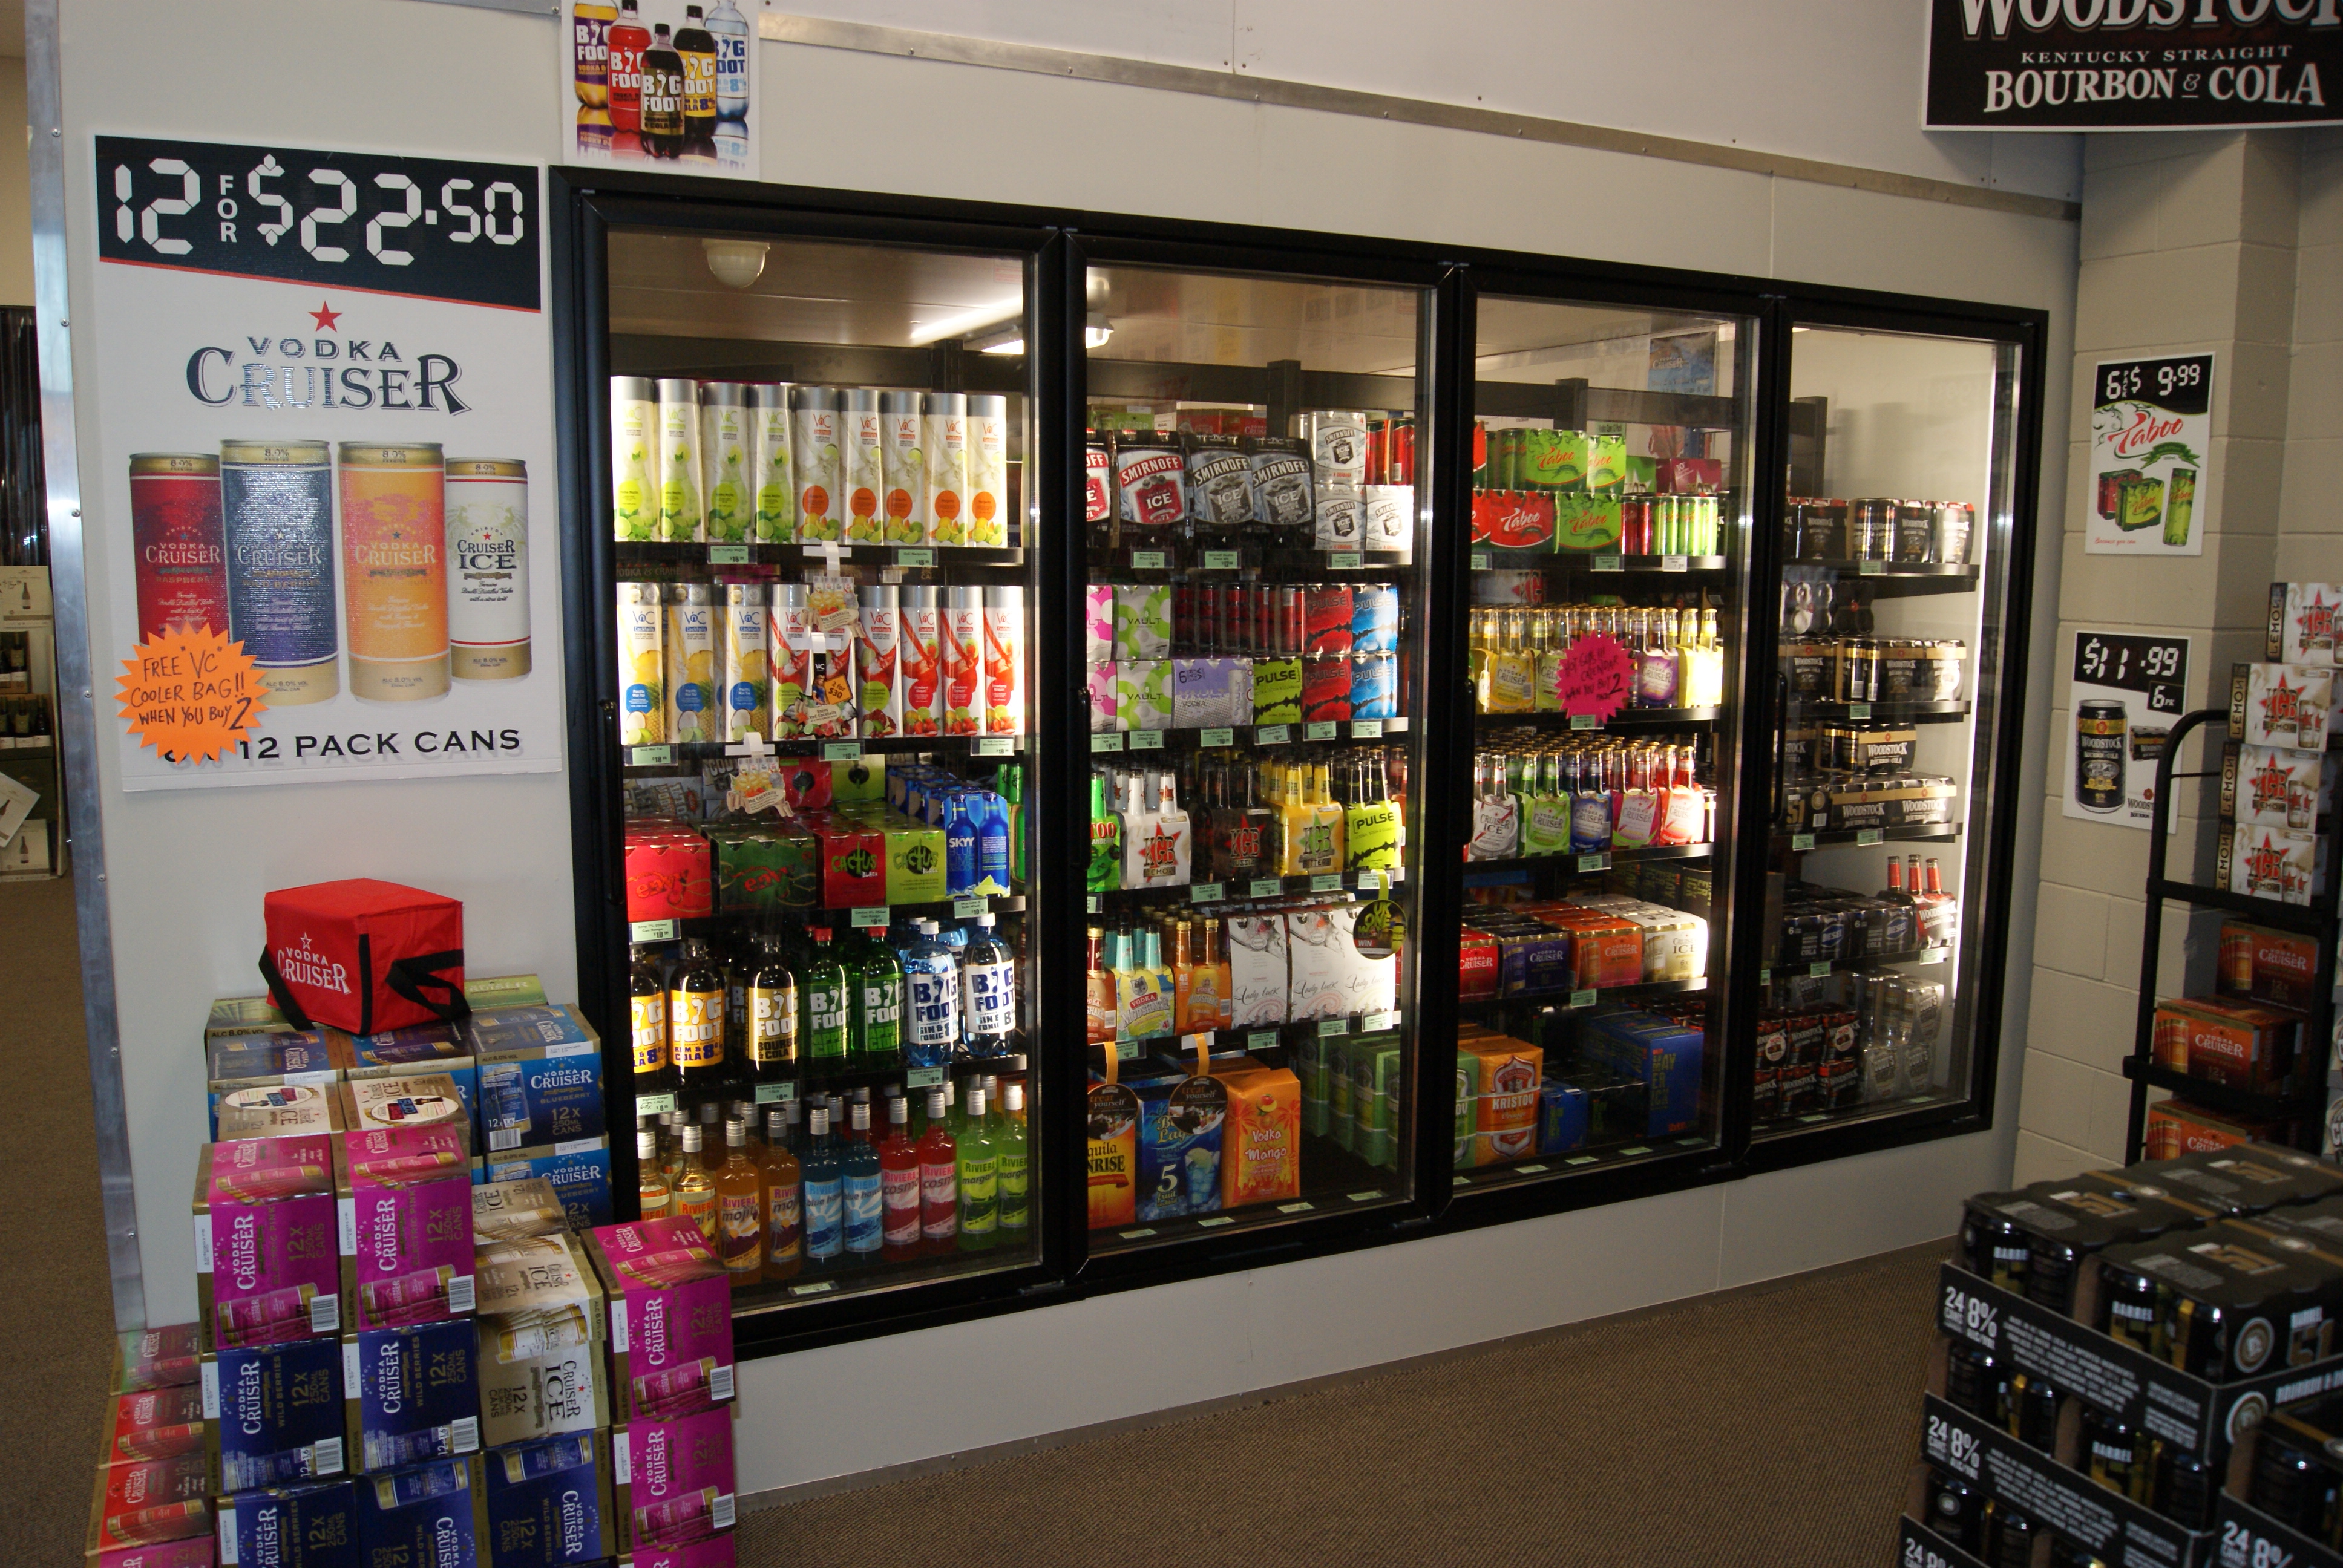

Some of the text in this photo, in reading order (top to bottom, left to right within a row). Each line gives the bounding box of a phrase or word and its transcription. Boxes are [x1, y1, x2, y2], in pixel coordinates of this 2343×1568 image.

[2022, 45, 2294, 64] KENTUCKY STRAIGHT
[1984, 63, 2325, 113] BOURBON & COLA
[644, 97, 681, 112] FOOT
[114, 158, 201, 255] 12
[217, 175, 238, 243] FOR
[246, 336, 403, 362] VODKA
[185, 346, 473, 417] CRUISER
[2106, 371, 2121, 399] 6
[2108, 411, 2184, 454] Taboo
[1122, 456, 1179, 484] SMIRNOFF
[1536, 446, 1575, 469] Taboo
[1195, 457, 1249, 486] SMIRNOFF
[1253, 460, 1308, 486] SMIRNOFF
[1146, 492, 1173, 509] ICE
[1274, 490, 1300, 505] ICE
[1501, 508, 1541, 531] Taboo
[146, 545, 221, 564] CRUISER
[238, 545, 322, 567] CRUISER
[355, 544, 436, 566] CRUISER
[457, 539, 516, 554] CRUISER
[459, 554, 517, 570] ICE
[2270, 596, 2281, 655] LEMON
[143, 656, 182, 682] FREE
[131, 685, 185, 708] COOLER
[2152, 685, 2166, 708] 6
[2232, 679, 2244, 735] LEMON
[139, 697, 252, 731] WHEN YOU BUY 2
[240, 737, 280, 760] 12
[295, 732, 400, 757] PACK
[414, 729, 520, 753] CANS
[1867, 742, 1908, 756] WOODSTOCK
[2223, 757, 2235, 812] LEMON
[1843, 803, 1884, 818] WOODSTOCK
[1144, 835, 1175, 866] KGB
[286, 947, 329, 967] VODKA
[1529, 950, 1564, 963] CRUISER
[2259, 949, 2307, 970] CRUISER
[278, 949, 352, 995] CRUISER
[1130, 992, 1158, 1008] VODKA
[228, 1028, 251, 1037] 8.0%
[673, 1021, 721, 1042] FOOT
[2195, 1034, 2244, 1058] CRUISER
[531, 1070, 594, 1089] CRUISER
[544, 1068, 578, 1077] VODKA
[540, 1092, 591, 1104] BLUEBERRY
[552, 1125, 582, 1135] CANS
[1252, 1129, 1282, 1143] Vodka
[965, 1161, 995, 1172] RIVIERA
[1245, 1147, 1287, 1161] Mango
[541, 1166, 601, 1185] CRUISER
[554, 1165, 587, 1174] VODKA
[885, 1172, 917, 1183] RIVIERA
[1158, 1164, 1178, 1192] 5
[485, 1189, 505, 1212] ICE
[722, 1197, 756, 1208] RIVIERA
[378, 1196, 396, 1272] CRUISER
[454, 1205, 465, 1241] CANS
[237, 1212, 256, 1290] CRUISER
[315, 1223, 326, 1258] CANS
[1944, 1286, 1965, 1312] 24
[647, 1295, 664, 1366] CRUISER
[410, 1335, 420, 1381] BERRIES
[455, 1348, 467, 1383] CANS
[380, 1340, 401, 1414] CRUISER
[562, 1360, 582, 1419] CRUISER
[243, 1359, 261, 1435] CRUISER
[545, 1364, 566, 1421] ICE
[1928, 1415, 1948, 1441] 24
[649, 1428, 665, 1497] CRUISER
[562, 1489, 583, 1557] CRUISER
[575, 1503, 584, 1540] VODKA
[2222, 1520, 2250, 1552] 24
[1906, 1537, 1923, 1564] 24
